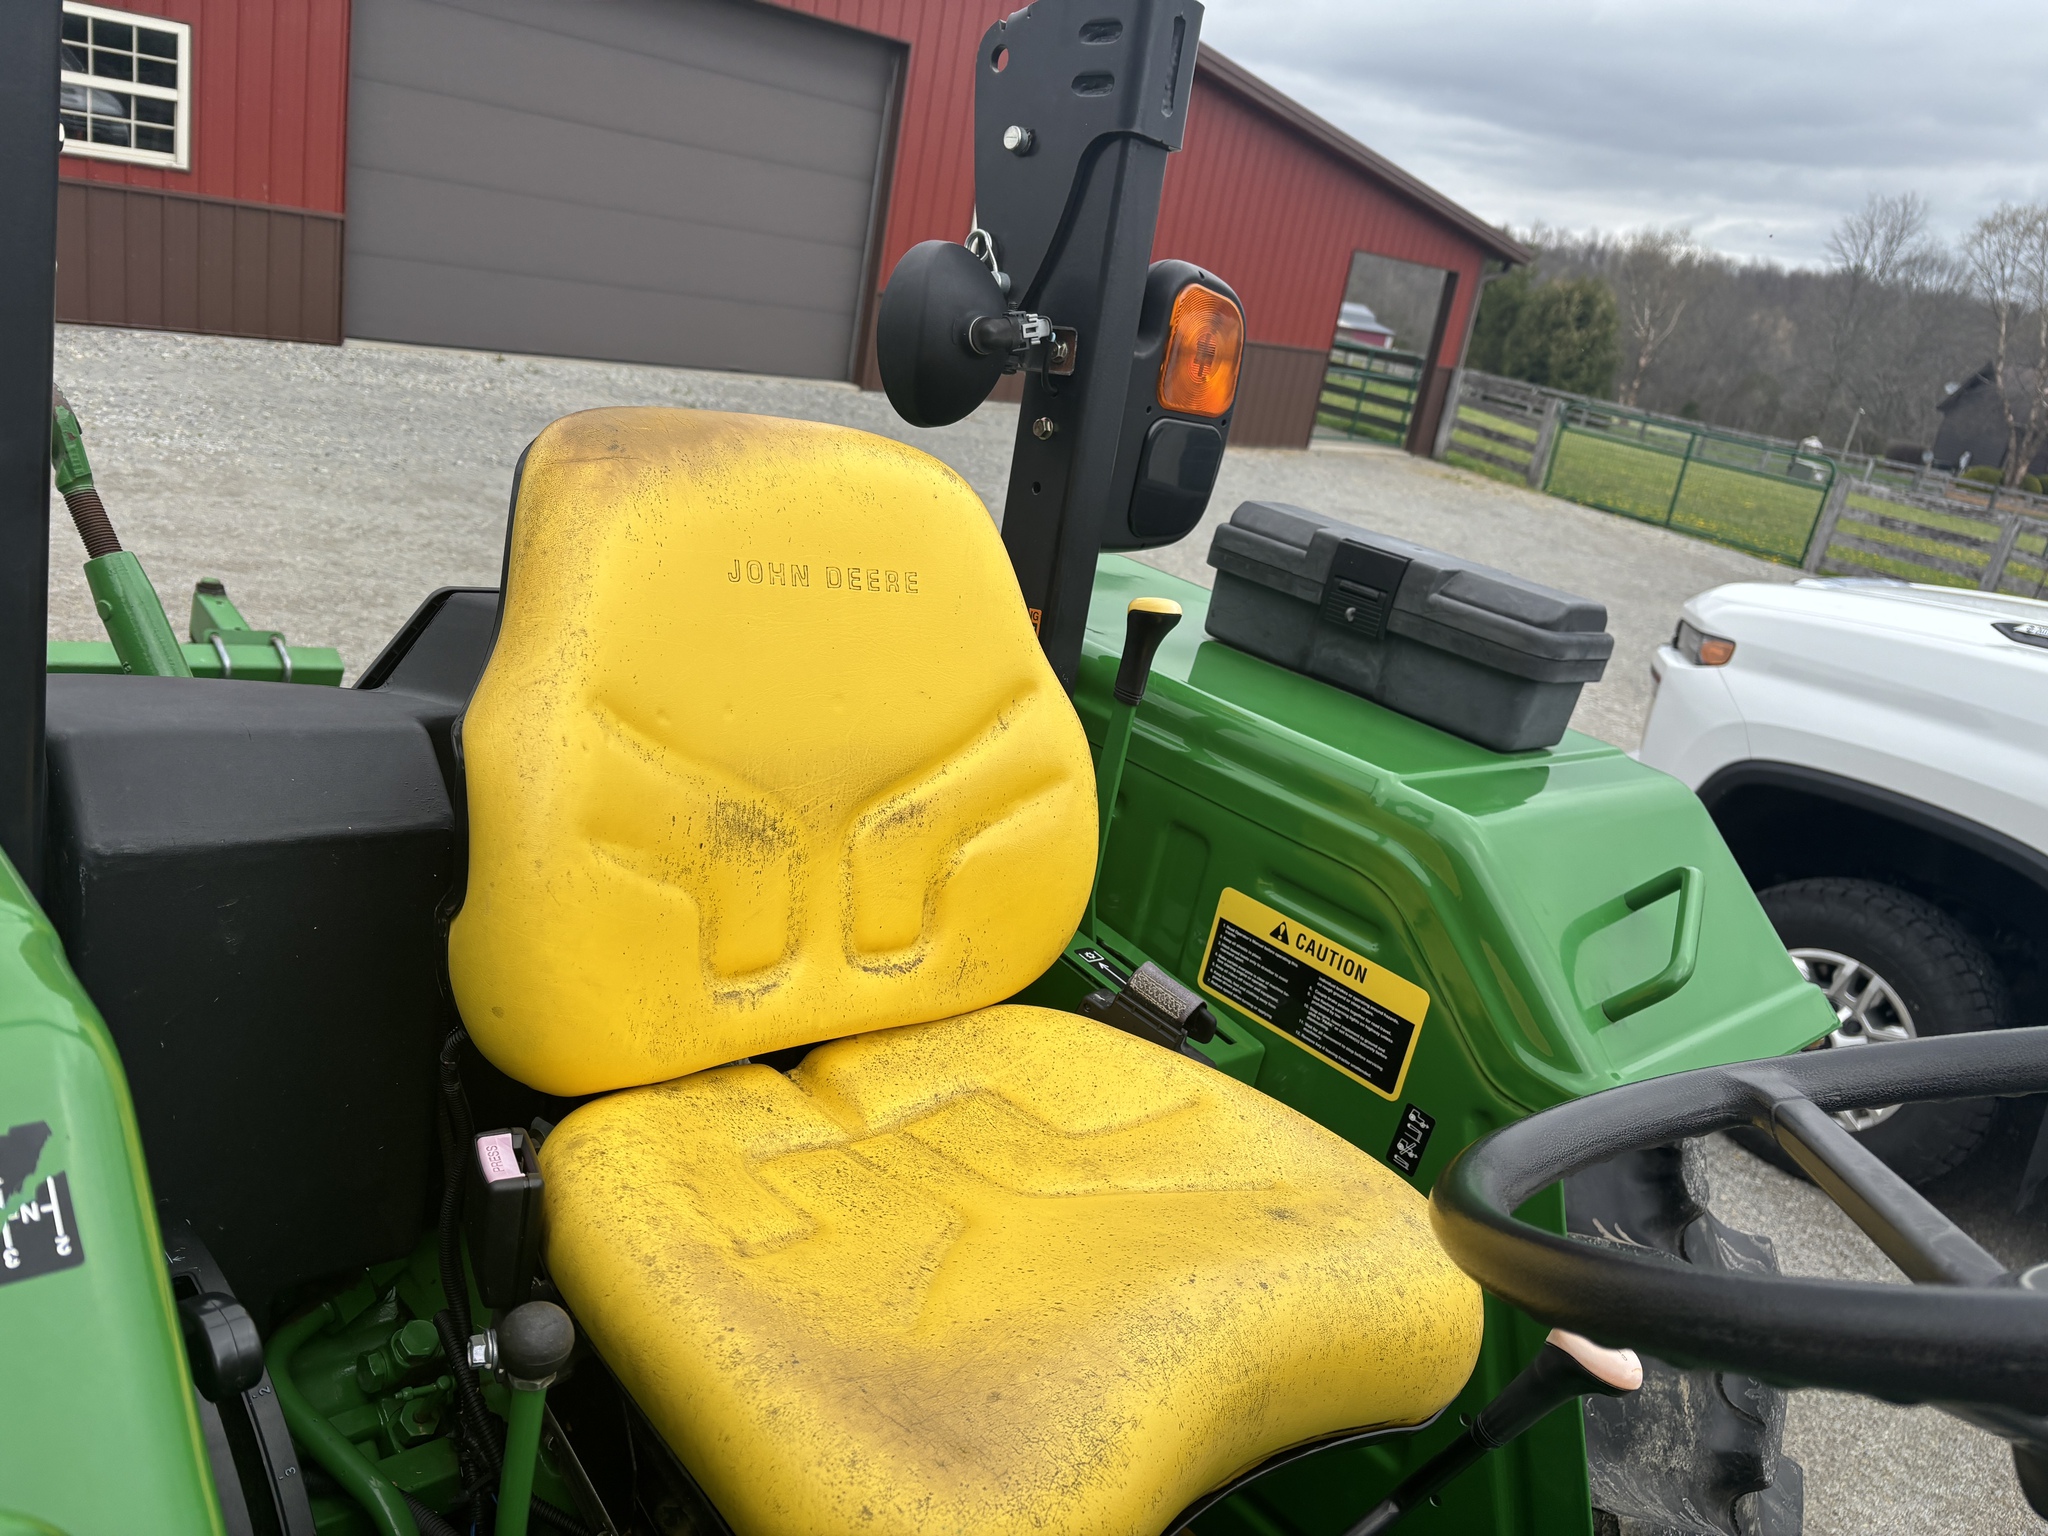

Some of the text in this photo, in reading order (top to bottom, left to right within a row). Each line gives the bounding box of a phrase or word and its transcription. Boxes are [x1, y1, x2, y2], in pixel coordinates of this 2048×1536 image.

[728, 559, 918, 593] JOHN DEERE
[1296, 933, 1368, 984] CAUTION
[486, 1145, 505, 1173] PRESS
[20, 1201, 41, 1224] N
[55, 1235, 72, 1256] 2
[3, 1248, 21, 1269] 3
[259, 1386, 271, 1396] 2
[285, 1466, 296, 1477] 3
